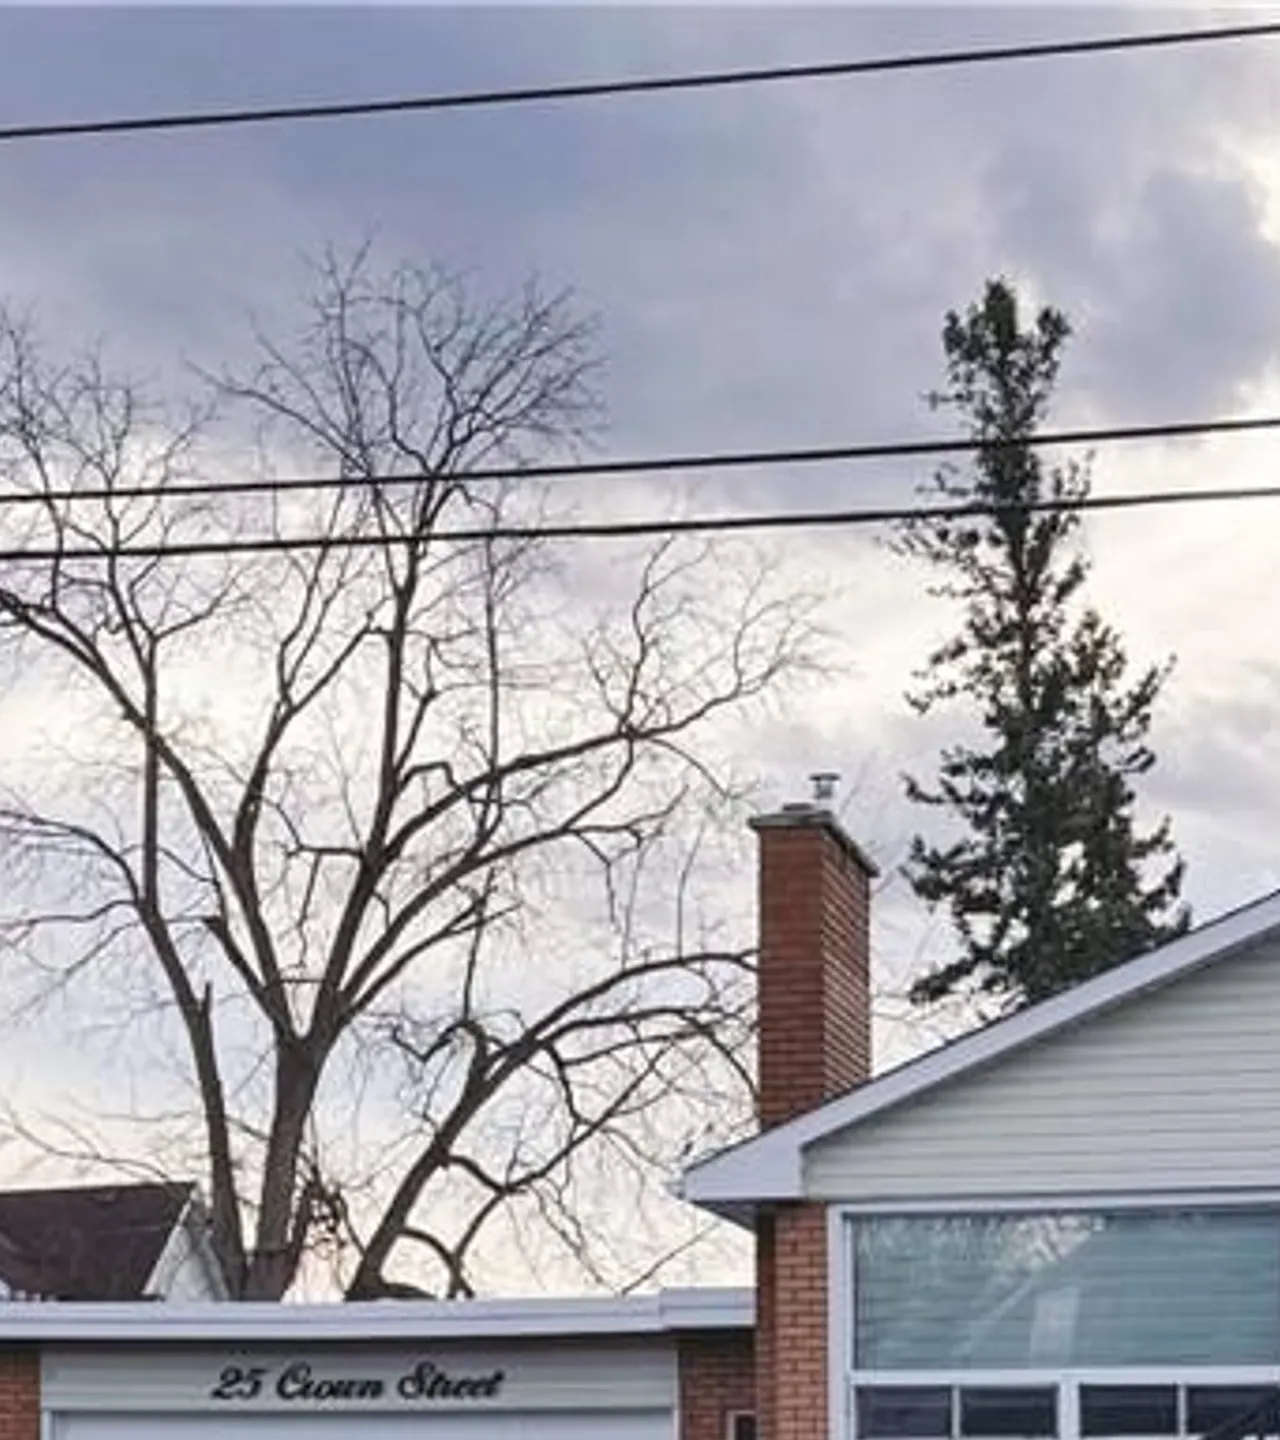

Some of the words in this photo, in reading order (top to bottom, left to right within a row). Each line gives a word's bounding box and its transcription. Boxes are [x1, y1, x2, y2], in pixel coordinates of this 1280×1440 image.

[211, 1366, 268, 1399] 25
[276, 1361, 383, 1400] Crown
[397, 1360, 506, 1400] Street
